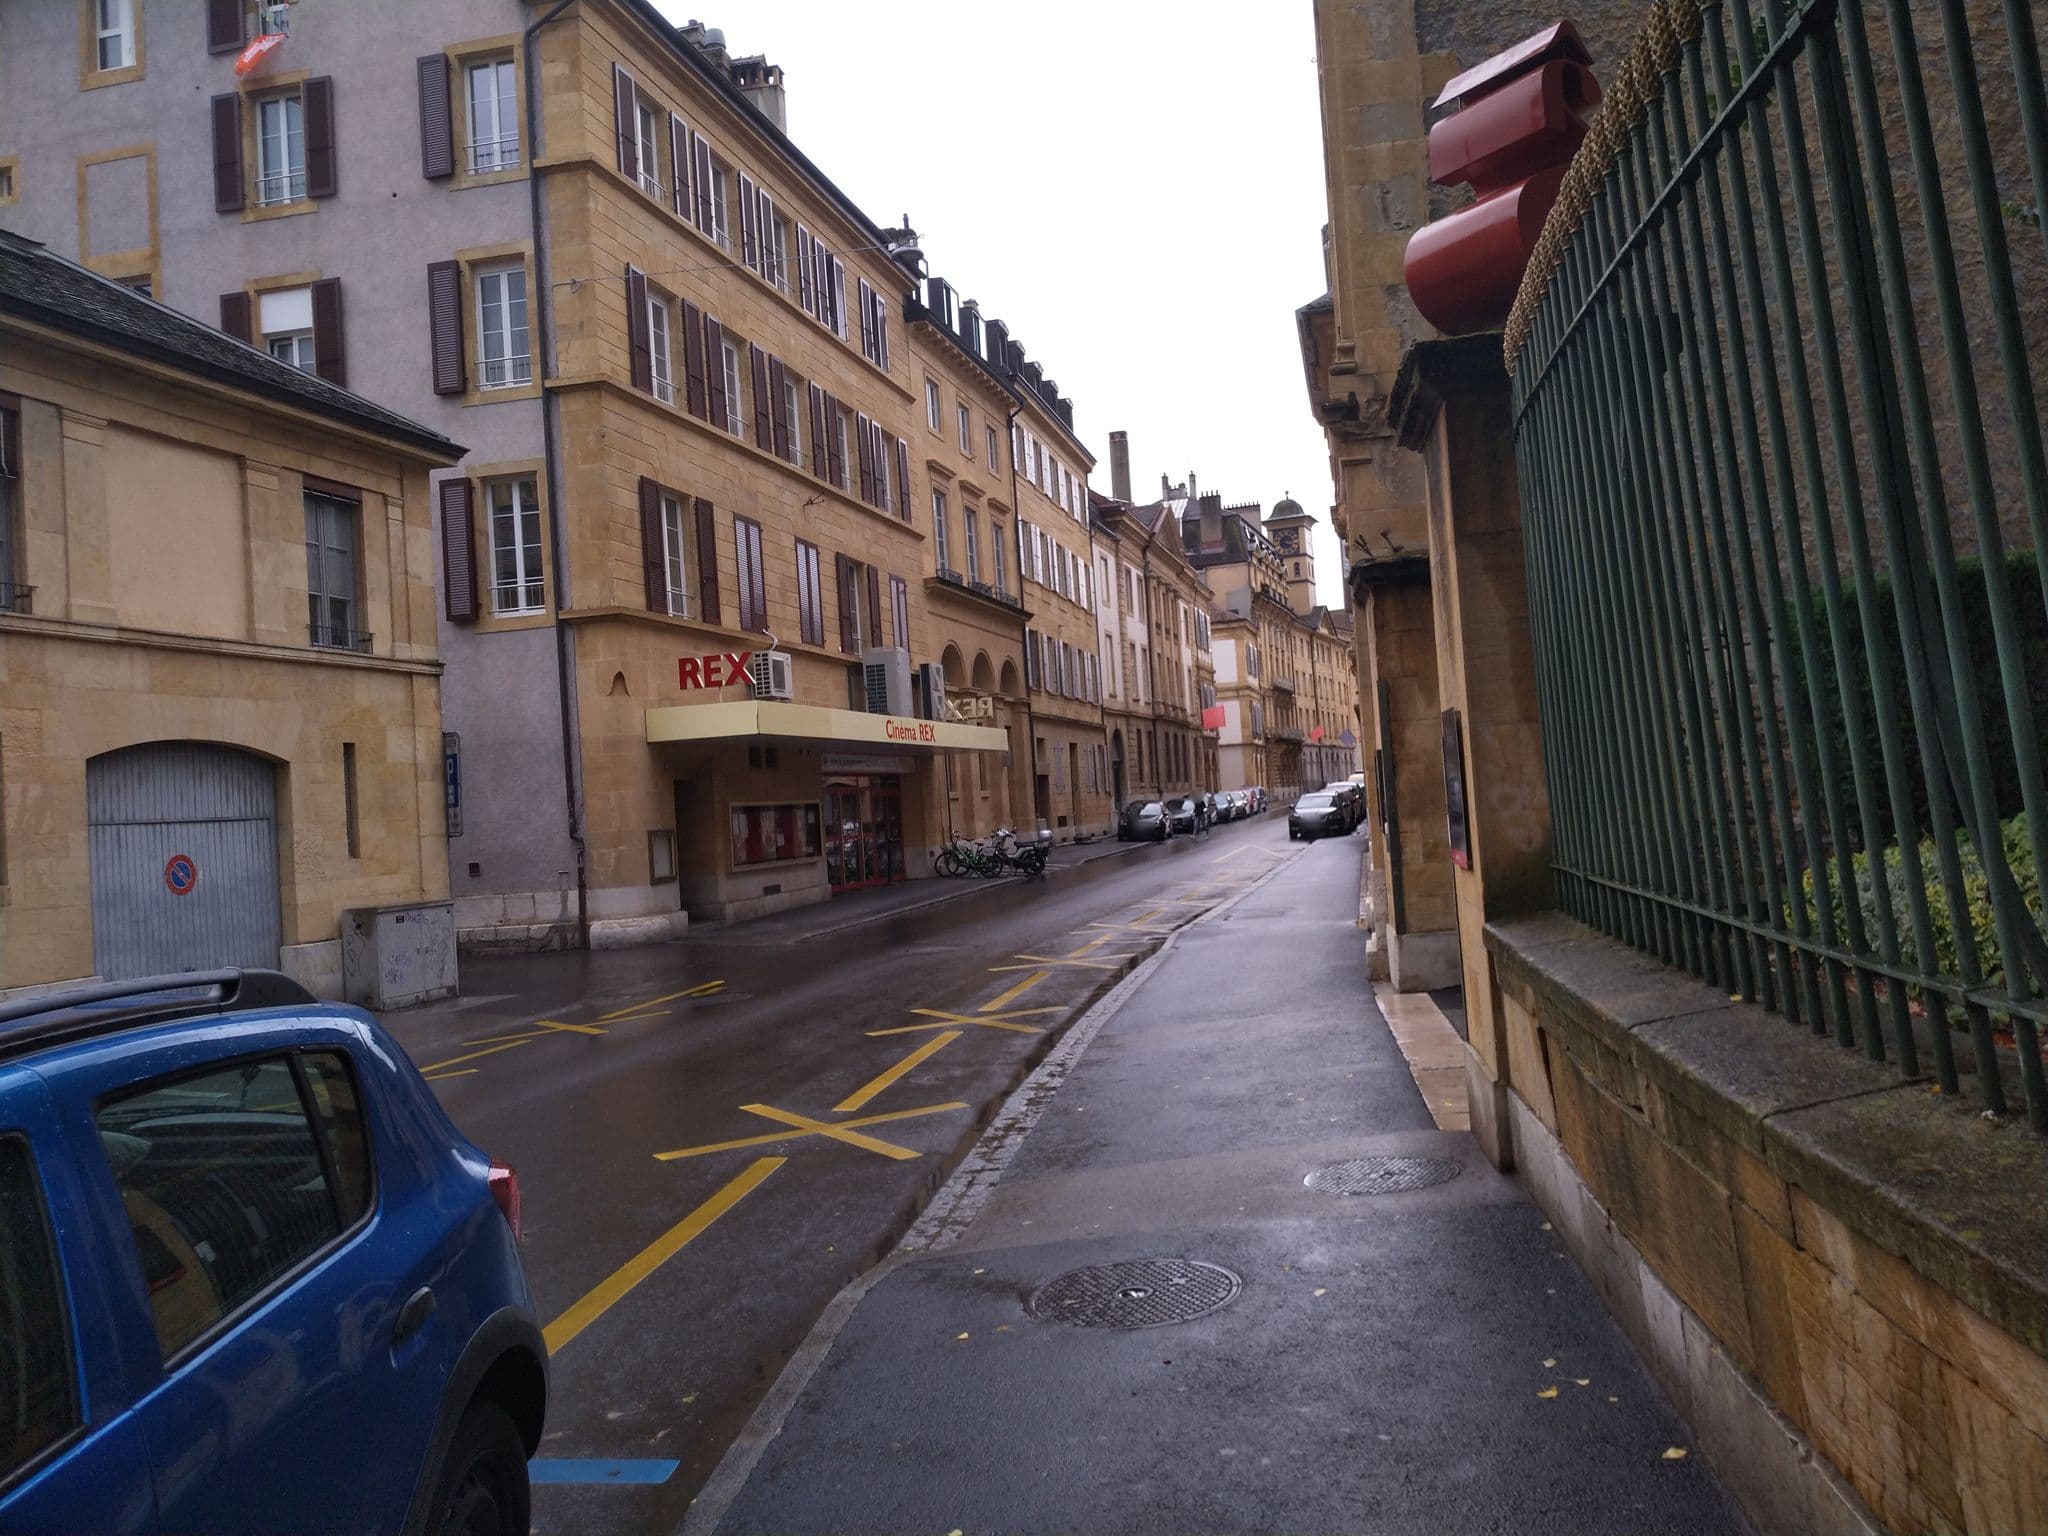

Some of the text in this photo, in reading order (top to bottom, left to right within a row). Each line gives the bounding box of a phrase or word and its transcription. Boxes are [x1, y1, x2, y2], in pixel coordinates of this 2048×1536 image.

[678, 651, 754, 690] REX
[885, 719, 937, 742] Cinéma REX
